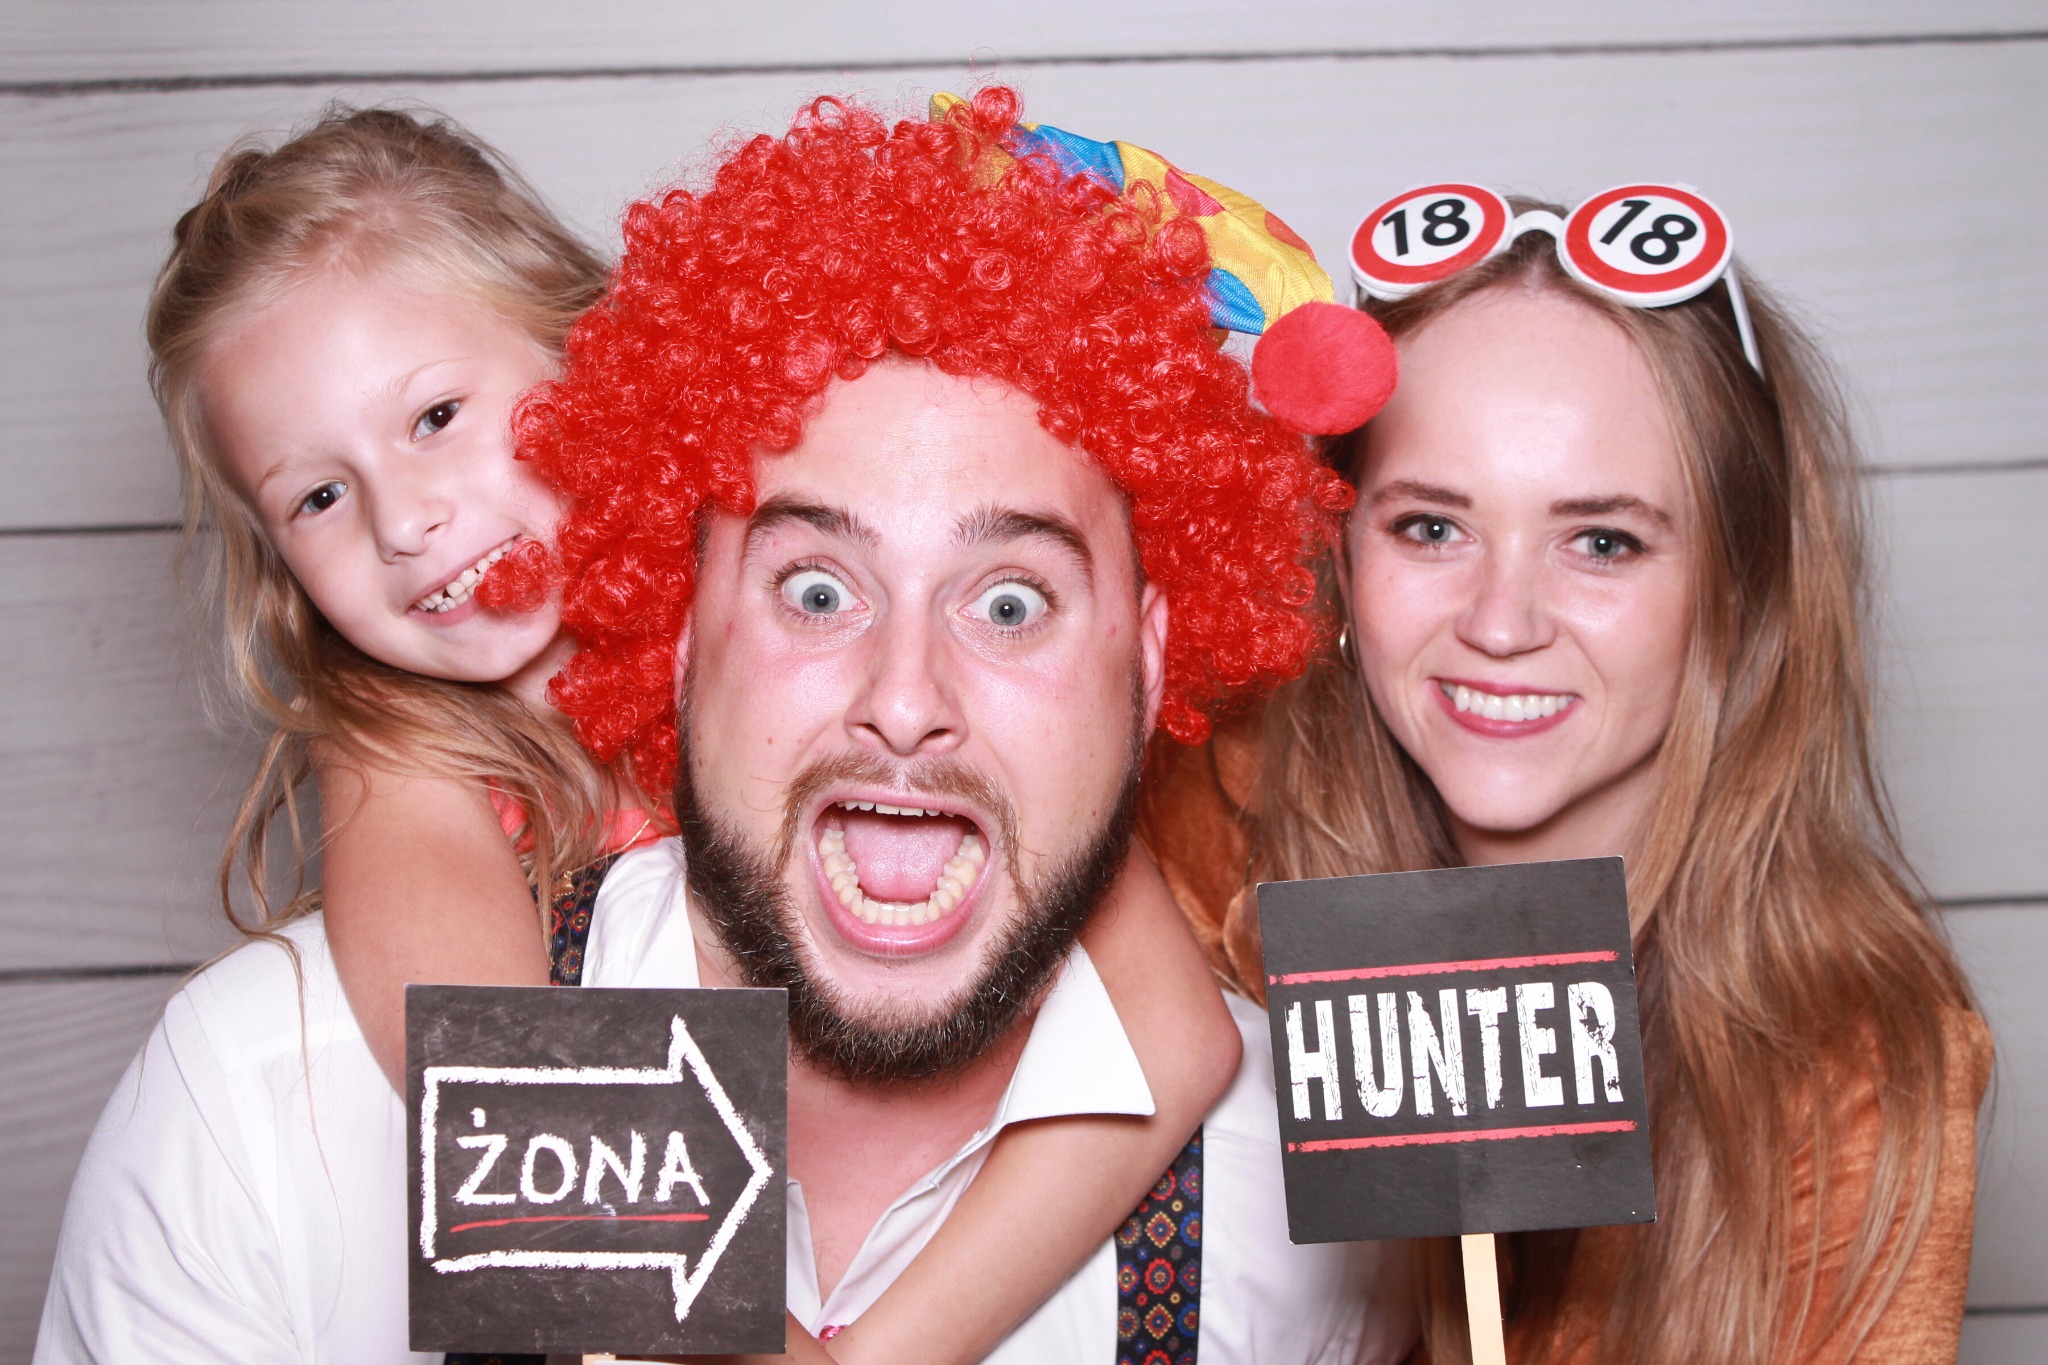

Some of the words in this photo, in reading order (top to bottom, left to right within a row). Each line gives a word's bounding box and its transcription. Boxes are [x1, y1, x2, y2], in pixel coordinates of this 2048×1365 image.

[1382, 198, 1470, 257] 18
[1599, 199, 1697, 265] 18
[1285, 981, 1624, 1121] HUNTER
[452, 1107, 710, 1206] ŻONA
